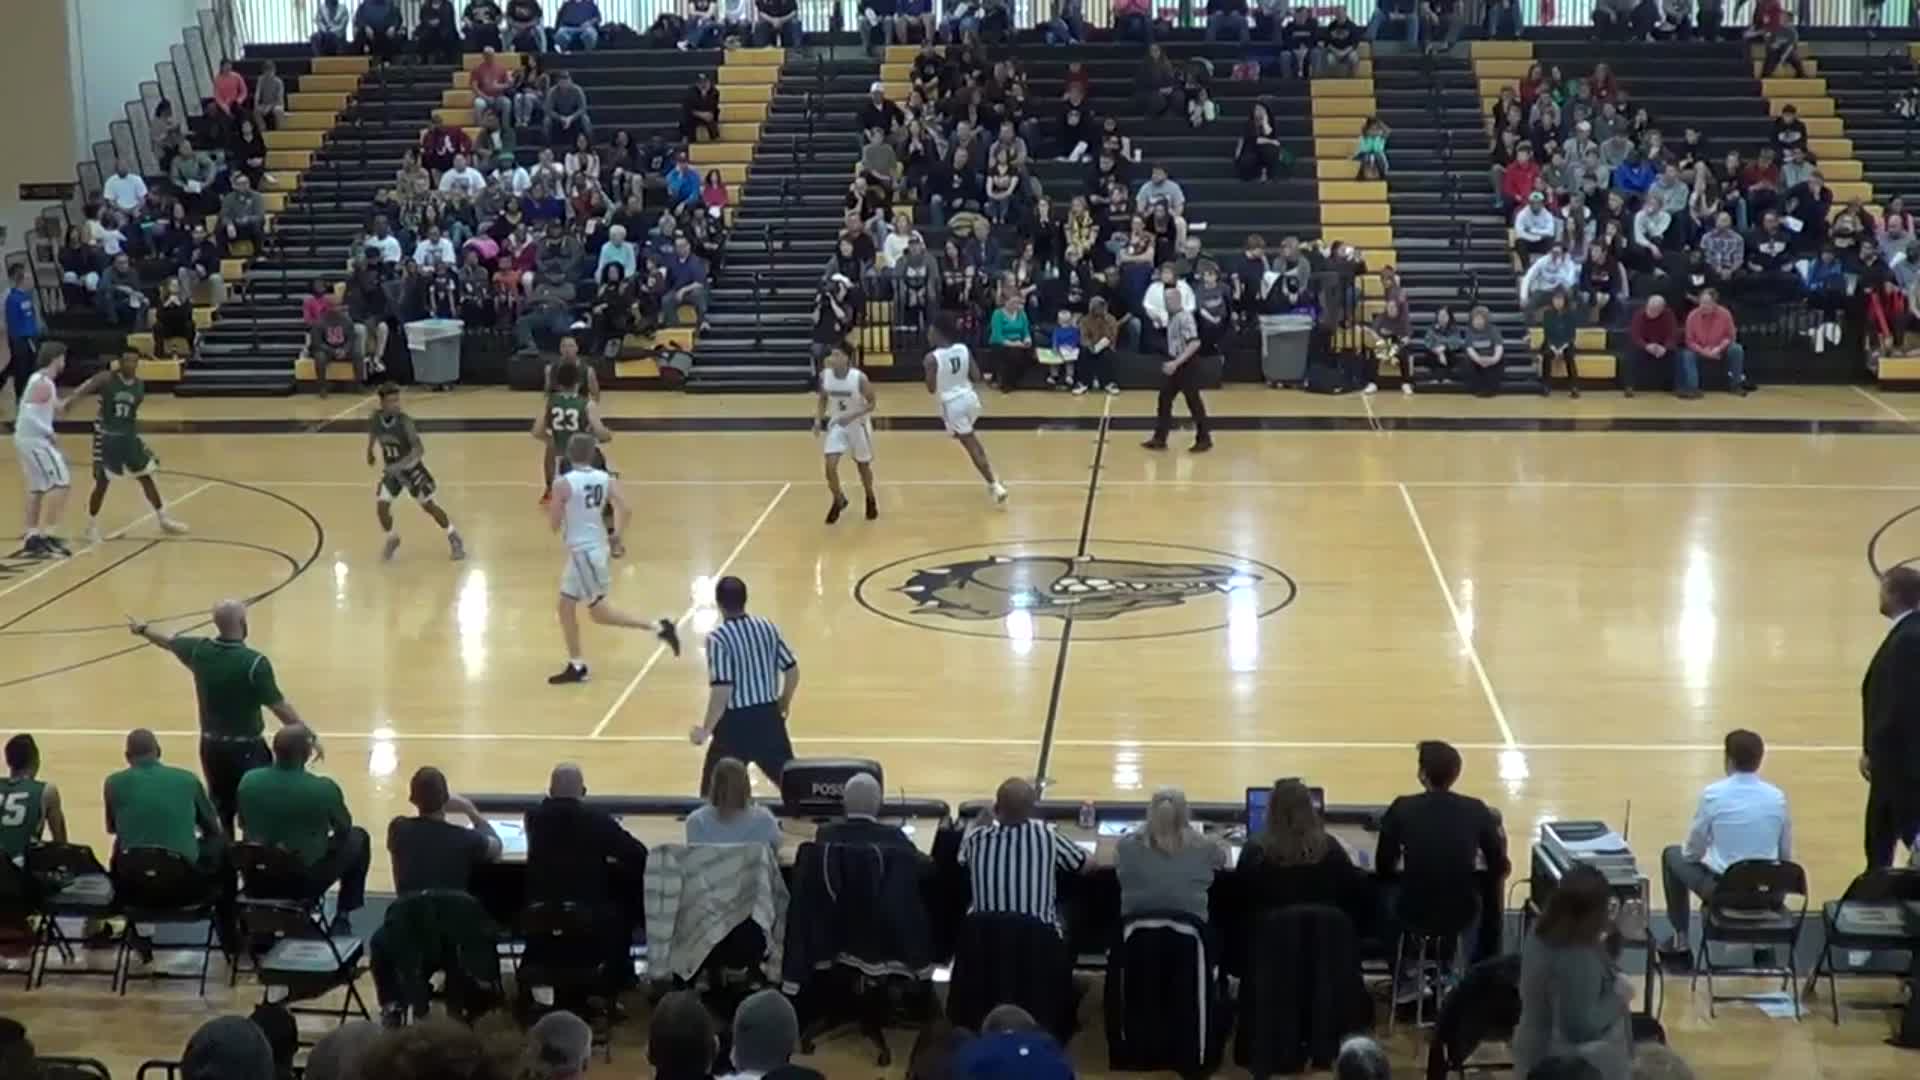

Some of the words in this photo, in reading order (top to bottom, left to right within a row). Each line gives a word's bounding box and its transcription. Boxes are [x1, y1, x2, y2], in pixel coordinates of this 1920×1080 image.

[551, 407, 579, 431] 23
[583, 484, 603, 509] 20
[0, 792, 29, 826] 5
